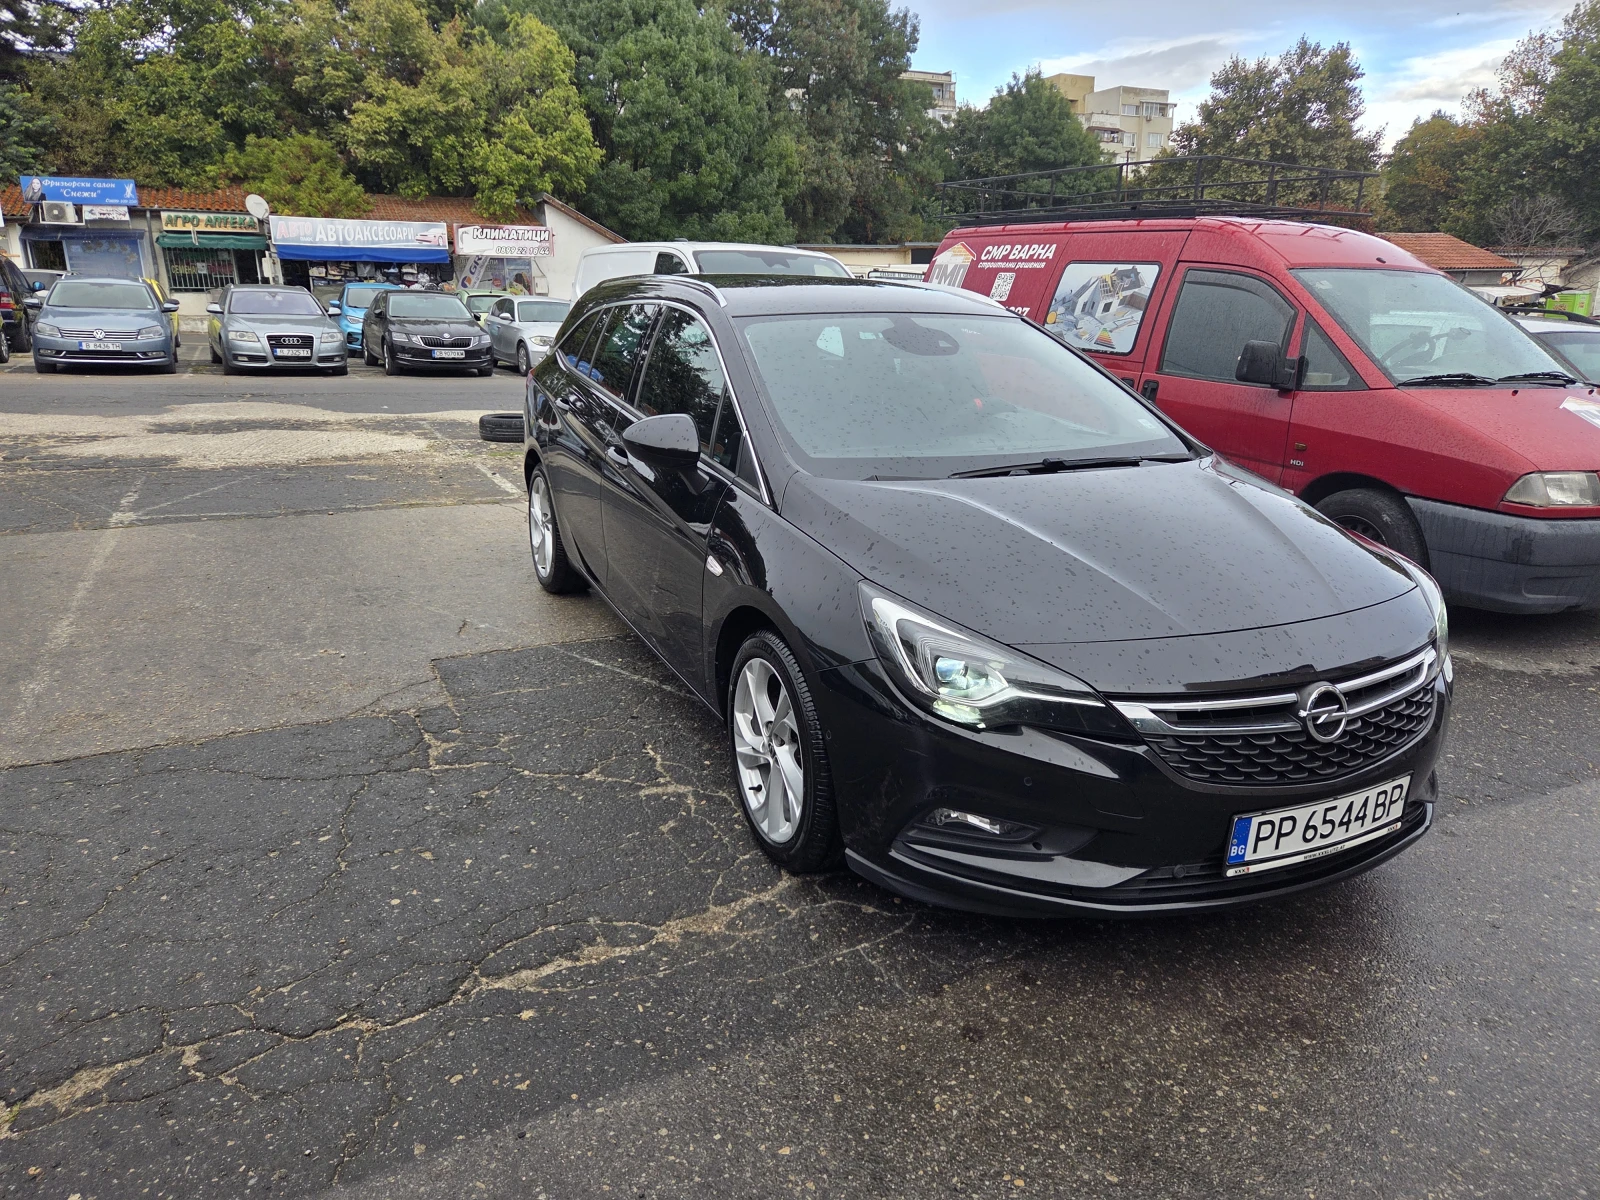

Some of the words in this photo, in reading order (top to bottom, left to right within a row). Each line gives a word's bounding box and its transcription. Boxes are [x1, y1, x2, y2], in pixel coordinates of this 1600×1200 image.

[165, 214, 200, 227] АГРО
[204, 215, 257, 229] АПТЕКА
[276, 220, 313, 239] АВТО
[315, 223, 415, 242] АВТОАКСЕСОАРИ
[473, 227, 550, 242] КЛИМАТИЦИ
[495, 245, 516, 255] 0899
[516, 246, 527, 255] 22
[539, 246, 550, 255] 44
[980, 244, 1012, 260] СМР
[1008, 243, 1057, 260] ВАРНА
[978, 261, 1017, 270] строителни
[1014, 261, 1046, 270] решения
[1230, 844, 1245, 857] BG
